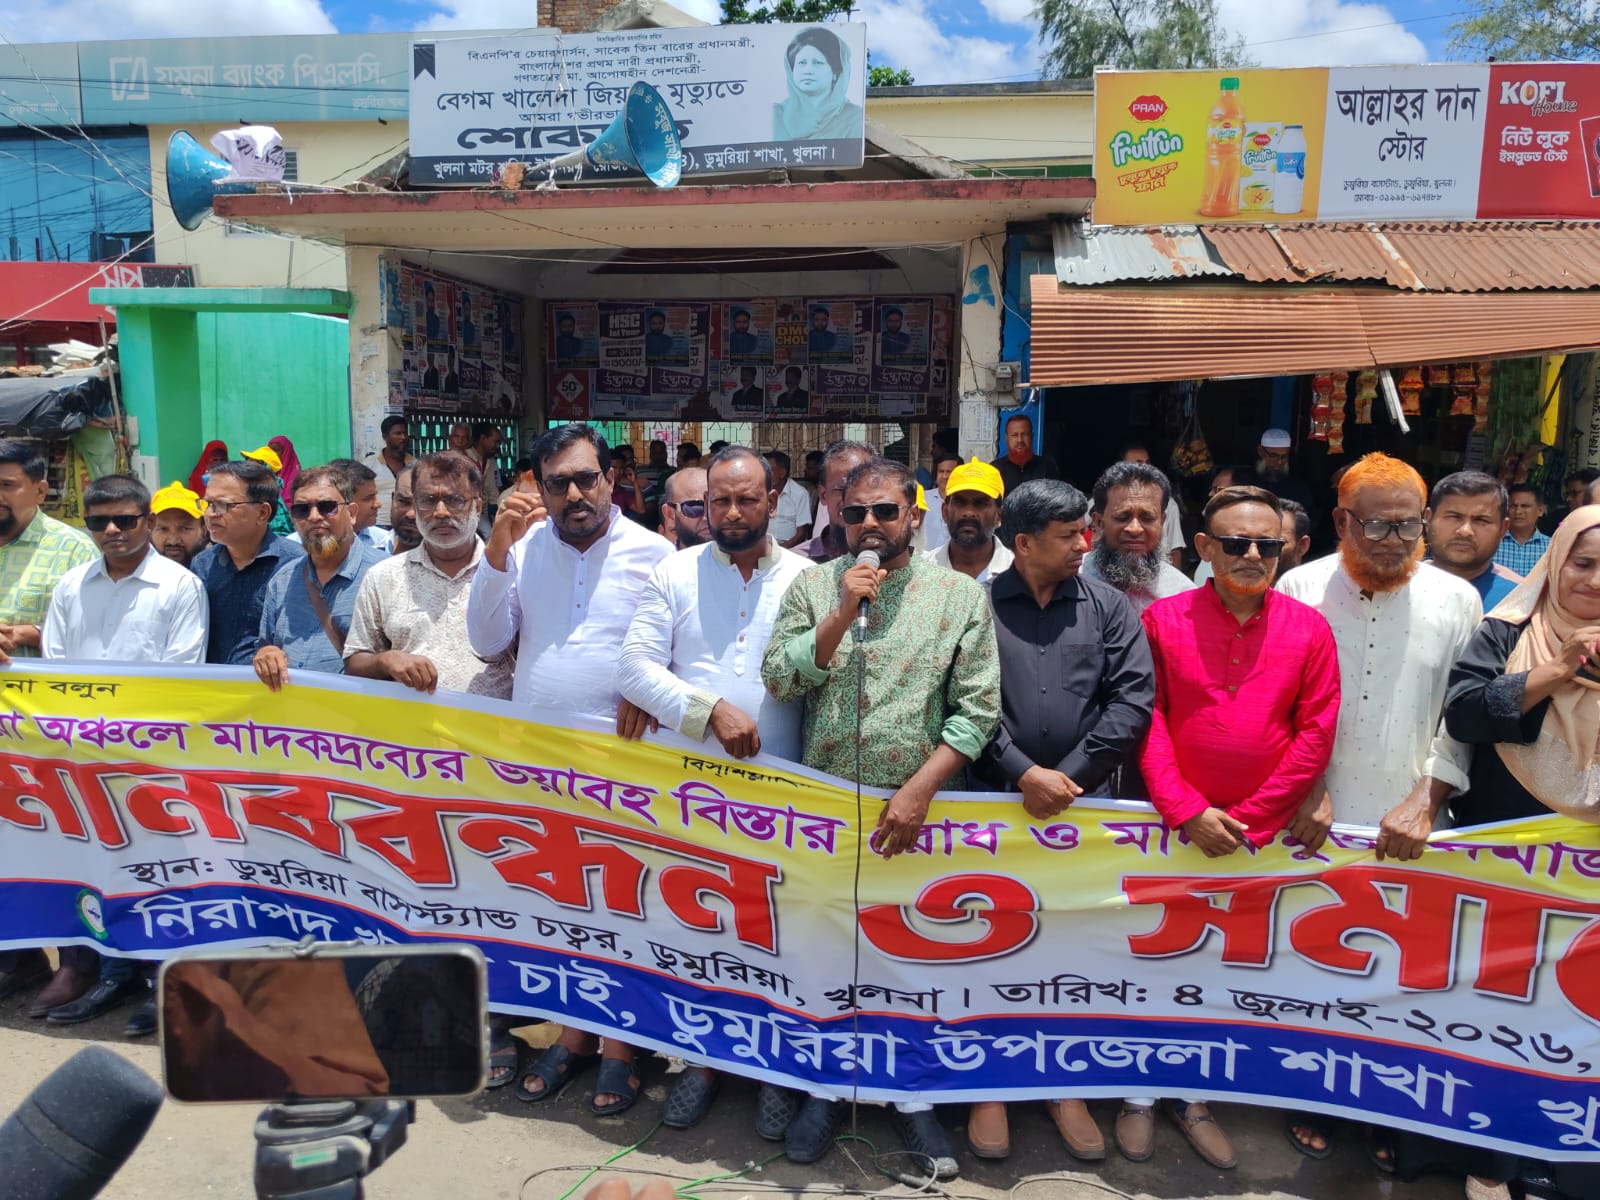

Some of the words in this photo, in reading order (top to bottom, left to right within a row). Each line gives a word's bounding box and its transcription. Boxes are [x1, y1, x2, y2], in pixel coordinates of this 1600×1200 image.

[586, 59, 613, 69] প্রথম
[617, 56, 641, 68] নারী
[593, 46, 631, 56] সাবেক
[633, 42, 657, 54] তিন
[661, 42, 695, 53] বারের
[154, 65, 216, 99] যমুনা
[222, 63, 285, 89] ব্যাংক
[436, 90, 495, 111] বেগম
[501, 87, 578, 110] খালেদা
[666, 79, 749, 108] মৃত্যুতে
[1499, 80, 1566, 105] KOFI
[518, 111, 561, 123] আমরা
[1132, 103, 1164, 113] PRAN
[1335, 84, 1429, 126] আল্লাহর
[1434, 82, 1481, 122] দান
[1531, 95, 1578, 117] House
[1378, 128, 1428, 163] স্টোর
[1500, 125, 1535, 147] নিউ
[1535, 130, 1571, 149] লুক
[433, 160, 466, 180] খুলনা
[703, 146, 750, 169] ডুমুরিয়া
[754, 146, 788, 165] শাখা,
[1543, 148, 1569, 162] টেস্ট
[4, 678, 38, 694] না
[46, 681, 123, 700] বলুন
[33, 716, 192, 751] অঞ্চলে
[201, 719, 472, 783] মাদকদ্রব্যের
[483, 756, 659, 827] ভয়াবহ
[671, 780, 848, 855] বিস্তার
[1029, 822, 1082, 851] ও
[0, 752, 785, 958] মানববন্ধন
[857, 870, 1041, 965] ও
[226, 859, 351, 897] ডুমুরিয়া
[355, 879, 520, 931] বাসস্ট্যান্ড
[529, 914, 634, 961] চত্বর,
[646, 939, 808, 1008] ডুমুরিয়া,
[824, 983, 946, 1014] খুলনা
[1172, 984, 1204, 1006] ৪
[1227, 987, 1592, 1075] জুলাই-২০২৬,
[129, 892, 338, 942] নিরাপদ
[510, 958, 637, 1029] চাই,
[659, 991, 908, 1080] ডুমুরিয়া
[924, 1024, 1251, 1083] উপজেলা
[1269, 1045, 1492, 1131] শাখা,
